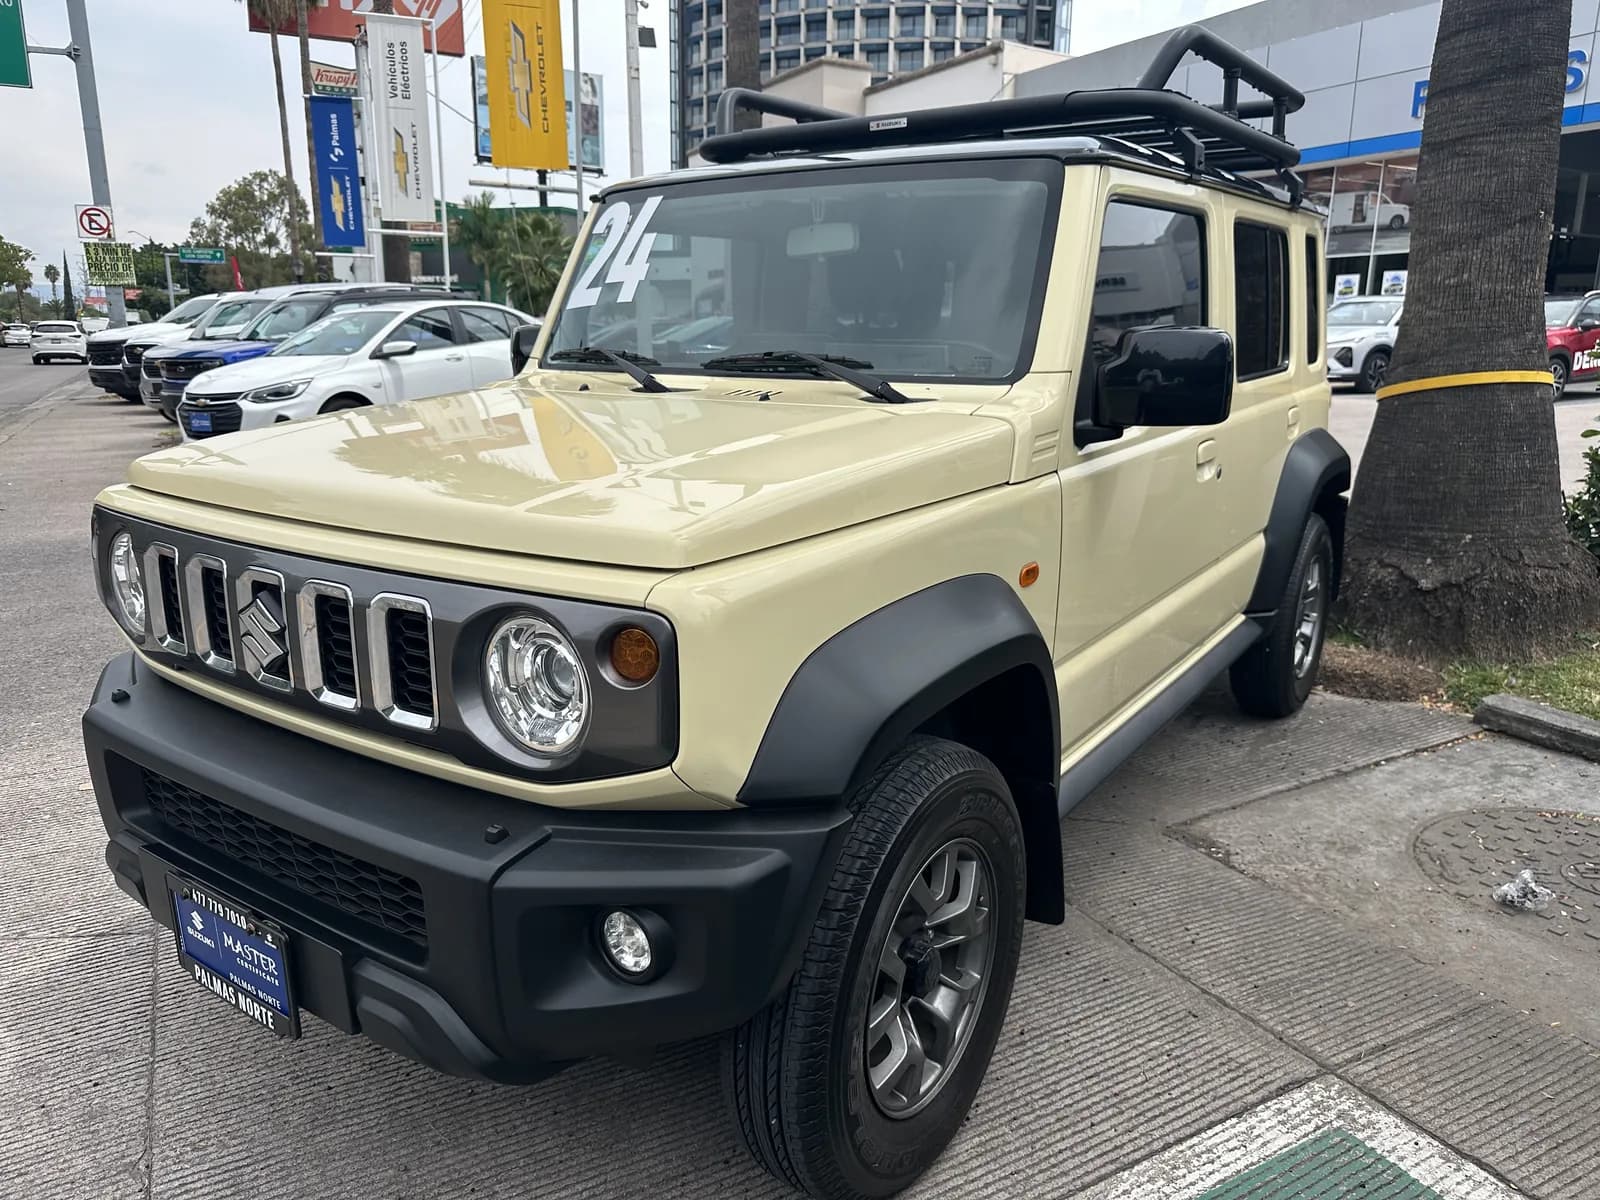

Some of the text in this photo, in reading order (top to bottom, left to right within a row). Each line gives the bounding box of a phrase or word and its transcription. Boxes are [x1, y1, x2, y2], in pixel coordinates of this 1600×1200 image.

[315, 69, 350, 86] Krispy
[386, 42, 399, 100] Vehículos
[399, 41, 411, 100] Eléctricos
[535, 21, 549, 134] CHEVROLET
[330, 113, 340, 146] Palmas
[410, 122, 422, 200] CHEVROLET
[344, 175, 355, 231] CHEVROLET
[88, 263, 133, 272] PRECIO DE
[102, 248, 118, 256] MIN
[566, 195, 664, 310] 24
[208, 897, 224, 917] 779
[225, 907, 247, 930] 7010
[186, 926, 215, 949] SUZUKI
[223, 931, 279, 975] MASTER
[194, 963, 275, 1030] PALMAS NORTE
[229, 972, 282, 1010] PALMAS NORTE
